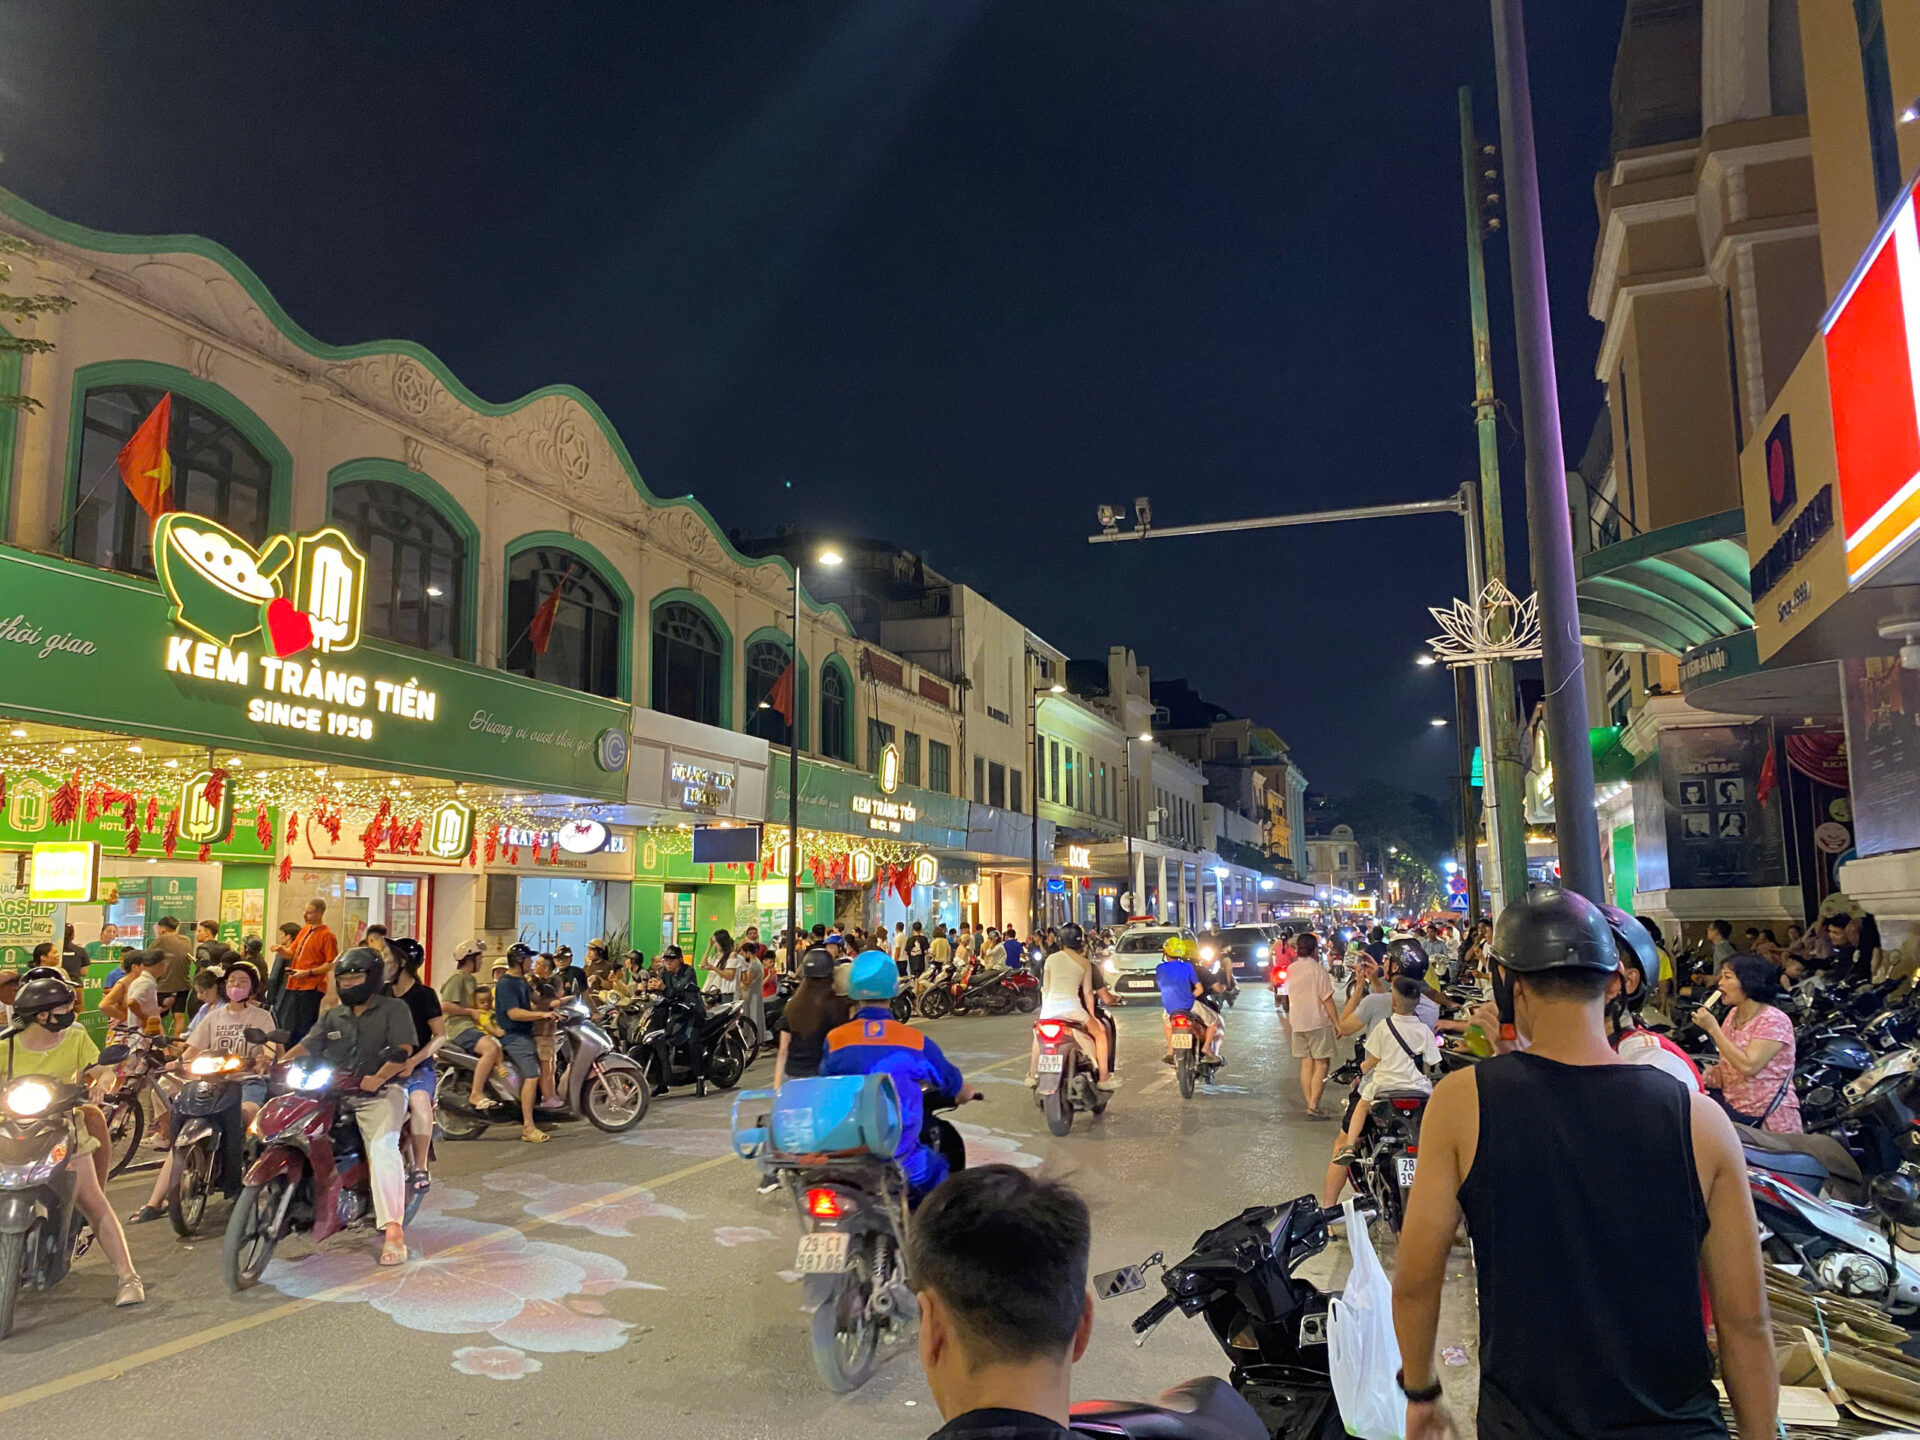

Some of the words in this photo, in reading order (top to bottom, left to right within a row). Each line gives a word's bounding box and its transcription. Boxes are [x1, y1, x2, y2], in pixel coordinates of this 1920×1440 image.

[38, 632, 97, 659] gian
[166, 636, 249, 686] KEM
[259, 657, 367, 707] TRÀNG
[374, 677, 437, 721] TIỀN
[248, 698, 322, 732] SINCE
[327, 712, 373, 740] 1958
[853, 795, 871, 814] KEM
[872, 797, 898, 819] TRÀNG
[870, 818, 888, 831] SINCE
[803, 1236, 842, 1252] 29-C1
